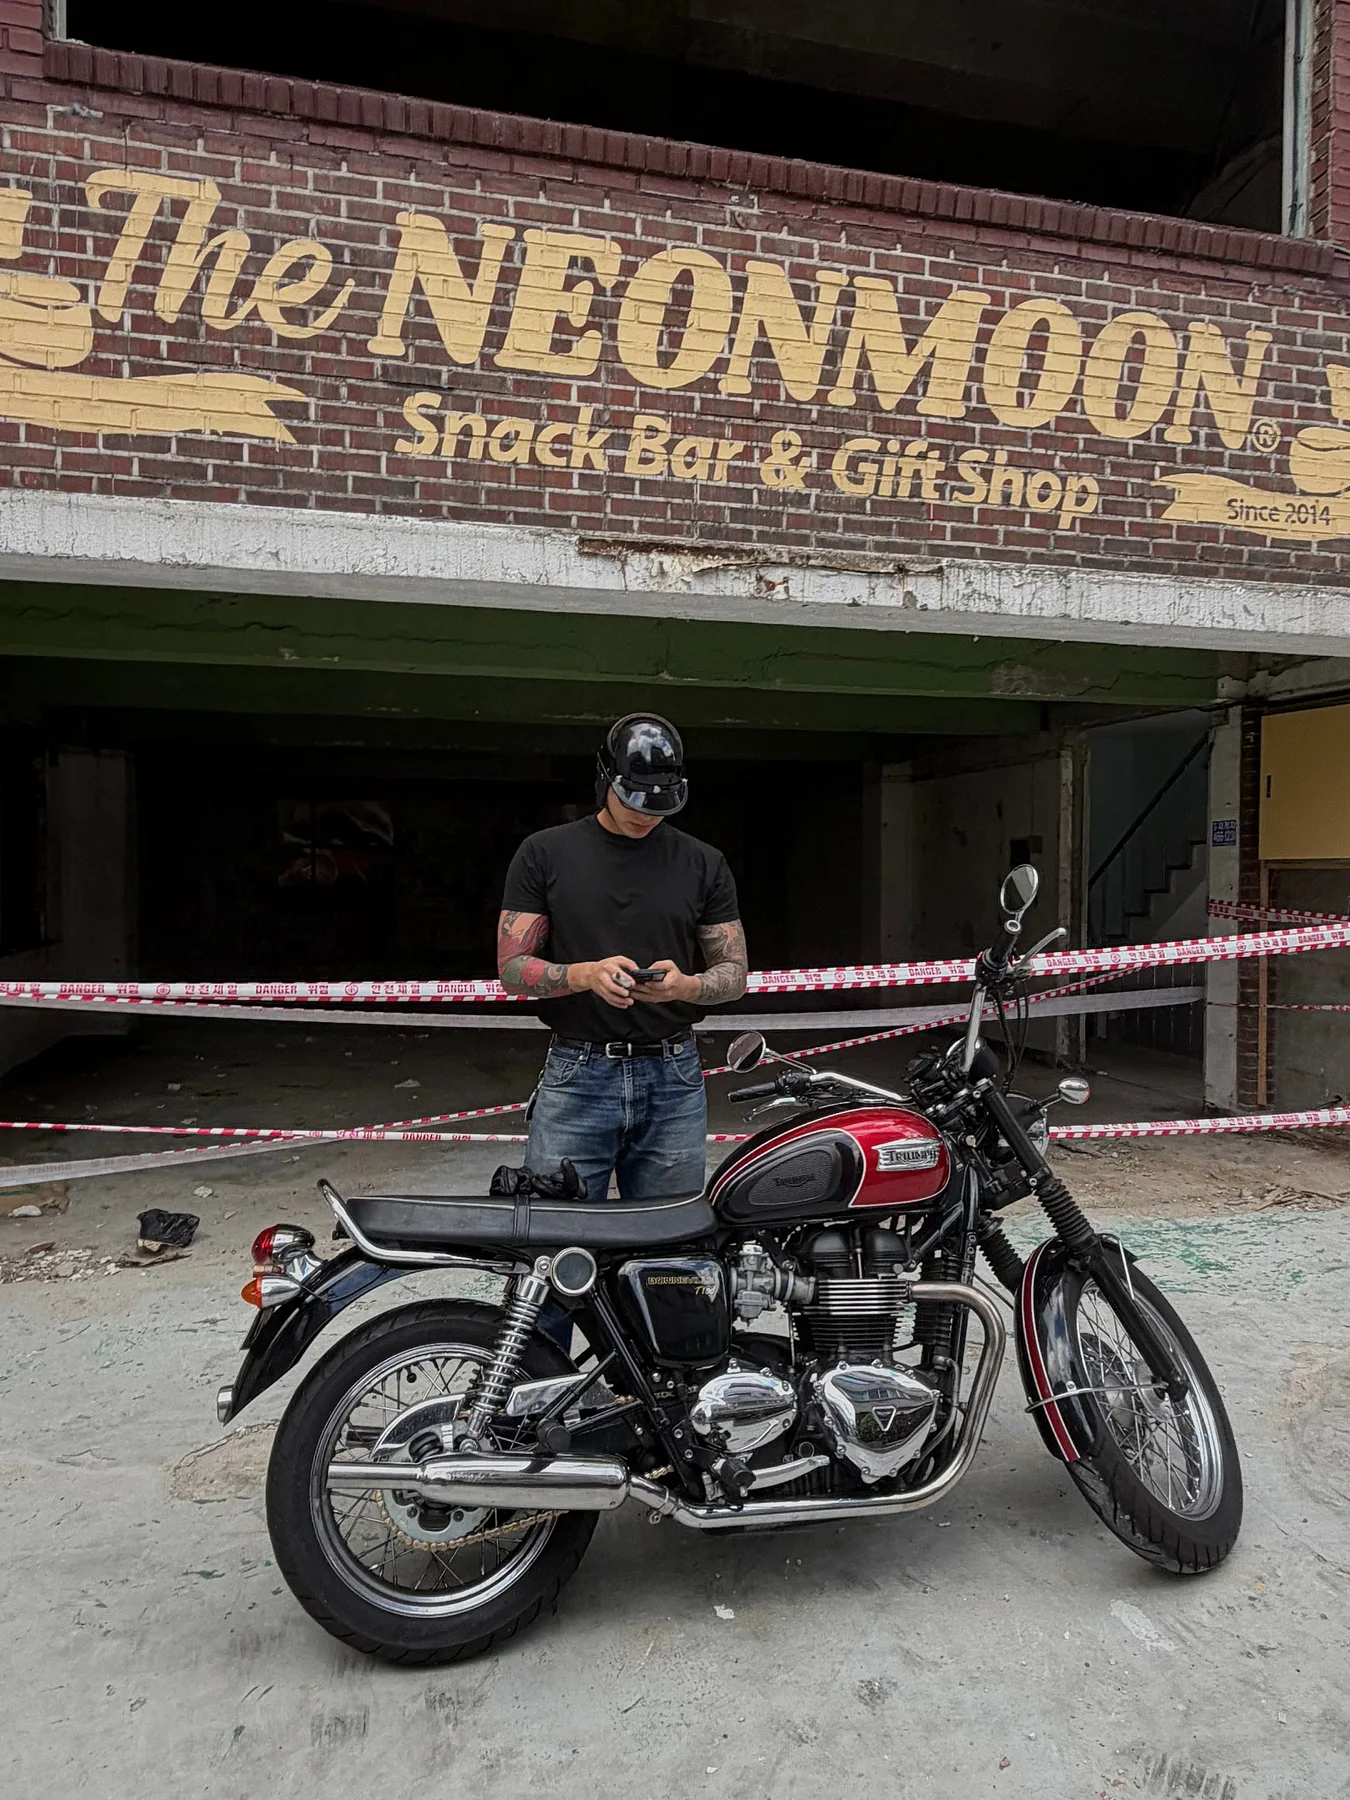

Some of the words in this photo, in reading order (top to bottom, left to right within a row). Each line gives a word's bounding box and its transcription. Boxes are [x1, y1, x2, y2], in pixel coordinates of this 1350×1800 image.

[86, 168, 354, 339] The
[394, 391, 611, 474] Snack
[623, 413, 744, 483] Bar
[760, 427, 813, 490] &
[831, 437, 945, 499] Gift
[951, 449, 1100, 529] Shop
[1226, 498, 1282, 524] Since
[1285, 502, 1332, 526] 2014
[1046, 956, 1078, 968] DANGER
[1176, 945, 1206, 957] DANGER
[1297, 932, 1326, 945] DANGER
[0, 983, 40, 993] 전제일
[60, 984, 105, 994] DANGER
[255, 984, 298, 995] DANGER
[437, 984, 476, 993] DANGER
[761, 974, 797, 985] DANGER
[908, 966, 942, 977] DANGER
